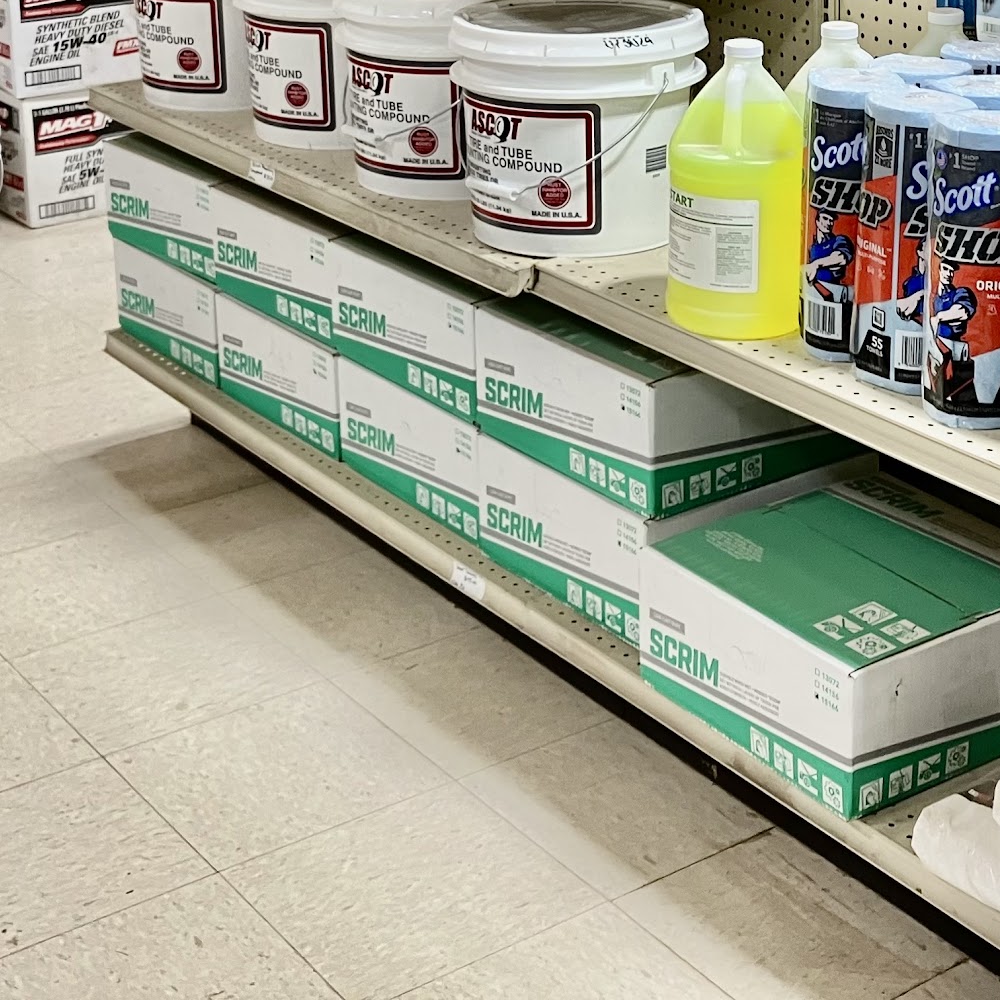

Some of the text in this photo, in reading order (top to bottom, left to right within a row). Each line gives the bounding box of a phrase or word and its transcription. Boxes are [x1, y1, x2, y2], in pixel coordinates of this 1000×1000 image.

[35, 19, 124, 44] HEAVY DUTY DIESEL
[36, 17, 88, 35] SYNTHETIC
[90, 10, 120, 25] BLEND
[150, 24, 171, 35] TUBE
[32, 33, 107, 57] SAE 15W-40
[147, 32, 194, 46] COMPOUND
[29, 48, 81, 67] ENGINE OIL
[258, 56, 280, 67] TUBE
[255, 64, 302, 79] COMPOUND
[369, 108, 430, 124] COMPOUND
[376, 99, 403, 112] TUBE
[39, 111, 107, 137] MAG1
[471, 108, 523, 143] ASCOT
[65, 153, 84, 165] FULL
[484, 144, 533, 160] and TUBE
[63, 159, 91, 174] HEAVY
[492, 154, 563, 174] COMPOUND
[59, 180, 90, 195] ENGINE
[62, 174, 78, 185] SAE
[934, 171, 997, 217] Scott
[111, 192, 149, 220] SCRIM
[561, 211, 582, 219] U.S.A.
[218, 241, 257, 272] SCRIM
[121, 288, 155, 318] SCRIM
[339, 301, 387, 337] SCRIM
[871, 335, 884, 349] 55
[223, 347, 263, 381] SCRIM
[485, 376, 544, 419] SCRIM
[347, 417, 395, 456] SCRIM
[843, 477, 946, 520] SCRIM
[486, 503, 543, 549] SCRIM
[649, 628, 719, 688] SCRIM
[822, 671, 840, 689] 13072
